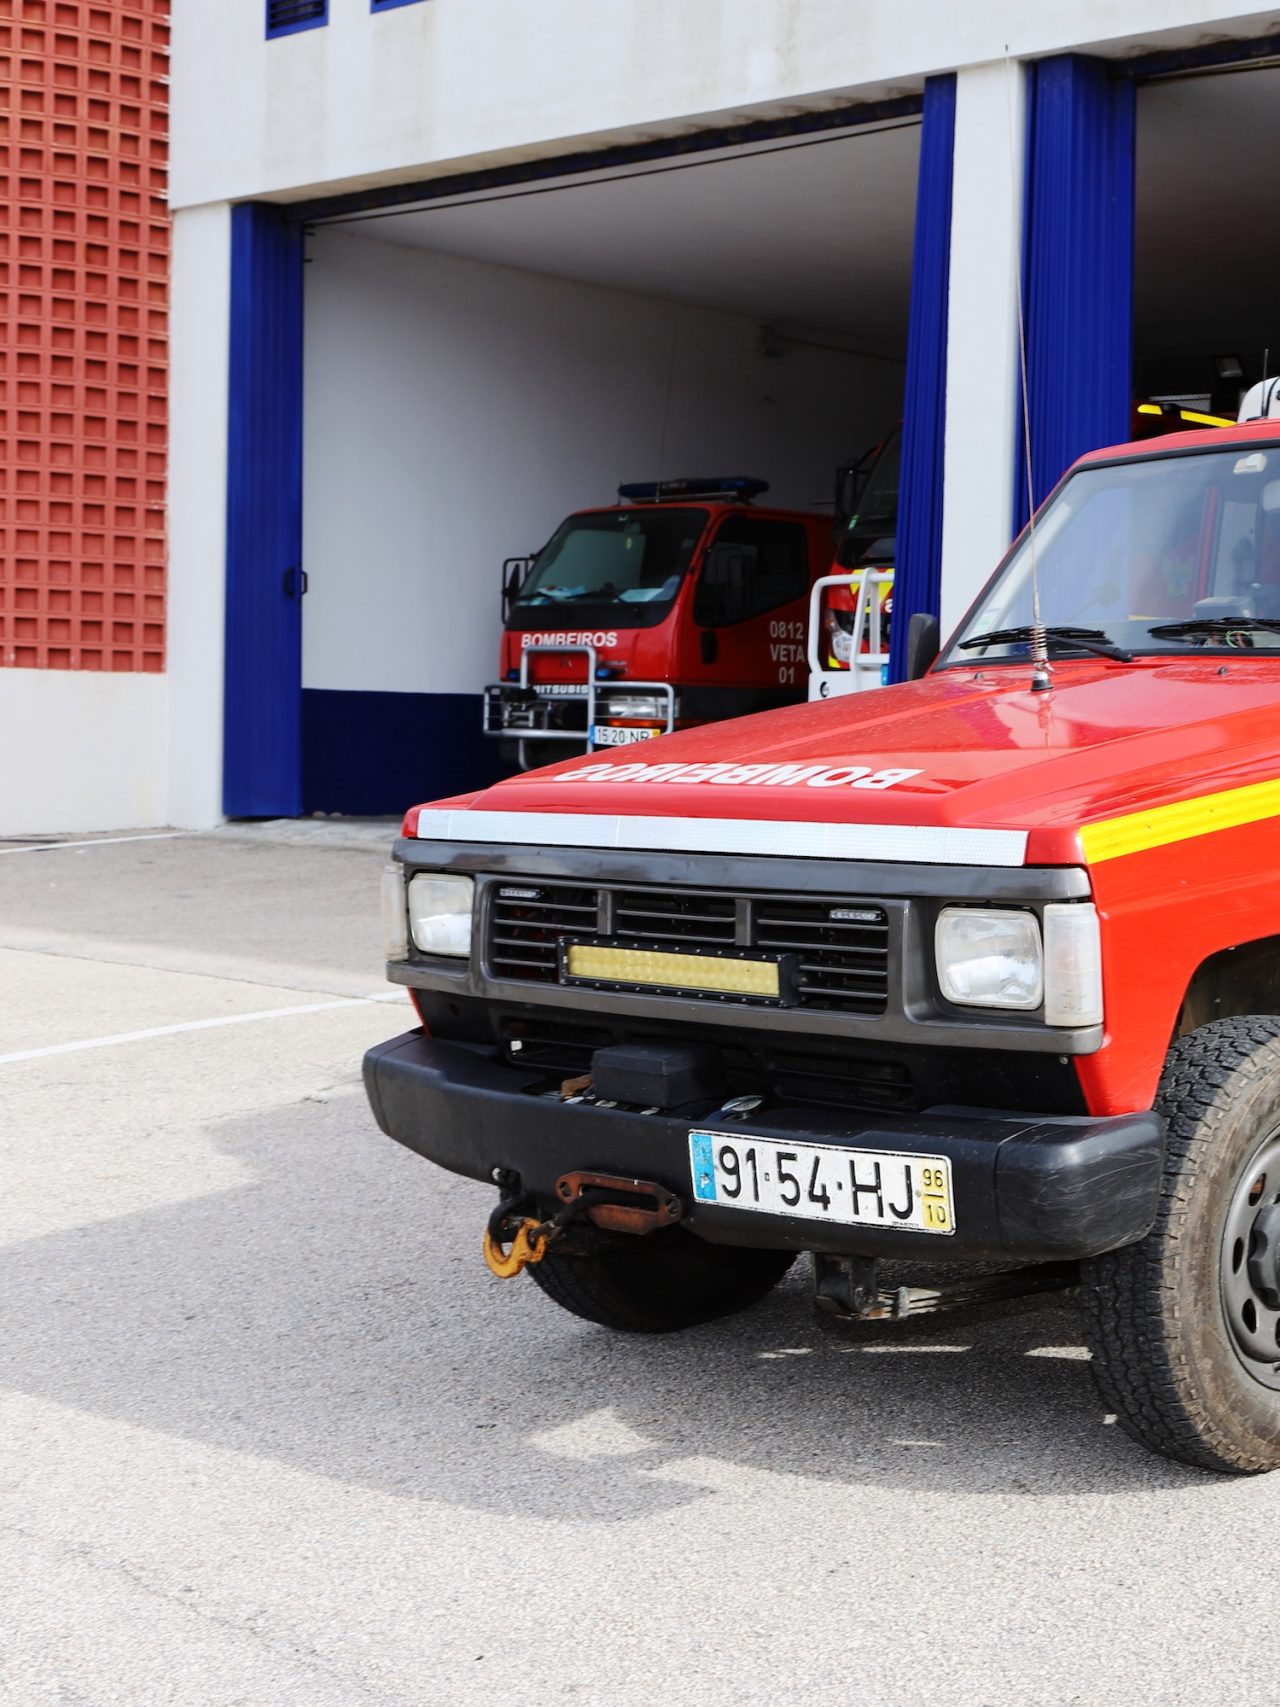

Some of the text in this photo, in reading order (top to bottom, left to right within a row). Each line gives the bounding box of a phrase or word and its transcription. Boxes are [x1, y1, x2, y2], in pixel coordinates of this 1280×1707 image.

[770, 621, 804, 639] 0812
[521, 632, 618, 648] BOMBEIROS
[770, 643, 805, 662] VETA
[779, 666, 795, 683] 01
[922, 1168, 944, 1187] 96
[927, 1204, 946, 1223] 10
